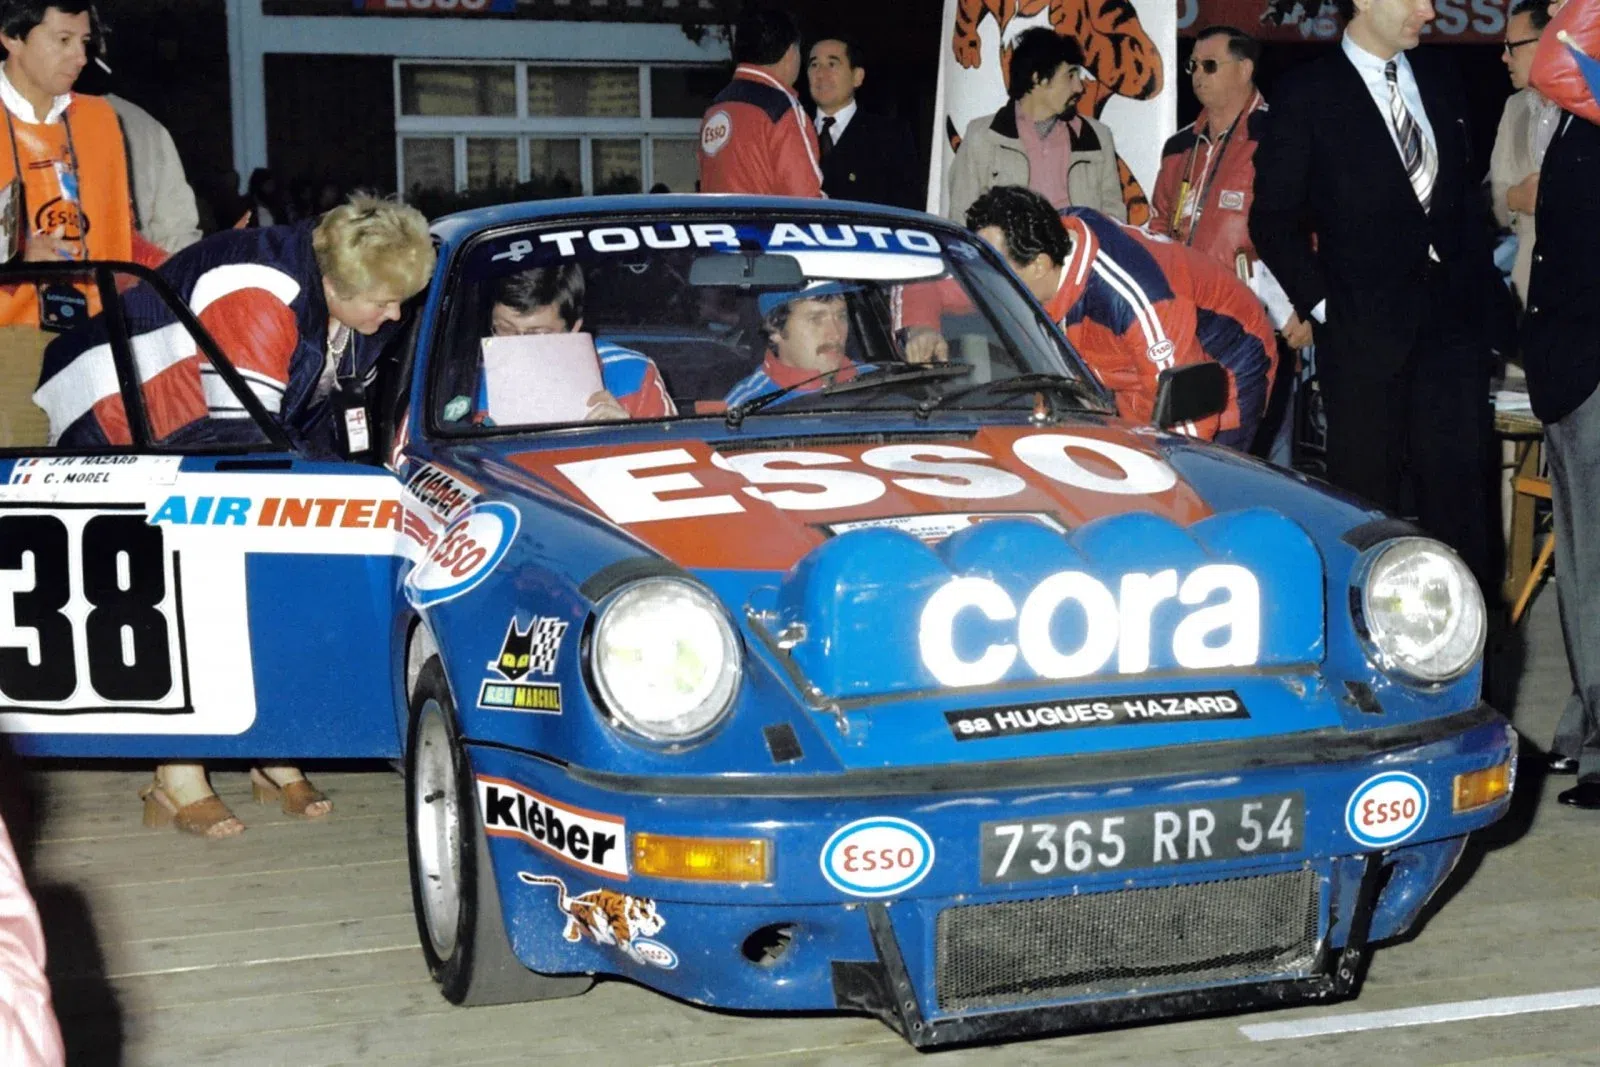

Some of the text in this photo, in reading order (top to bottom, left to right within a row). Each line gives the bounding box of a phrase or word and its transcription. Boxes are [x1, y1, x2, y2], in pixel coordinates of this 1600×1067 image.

[539, 222, 943, 257] TOUR AUTO
[63, 471, 111, 484] MOREL
[80, 455, 139, 466] HAZARD
[553, 434, 1178, 524] ESSO
[149, 495, 253, 526] AIR
[0, 514, 174, 701] 38
[918, 563, 1261, 688] cora
[957, 694, 1239, 735] sa HUGUES HAZARD
[485, 785, 617, 866] kléber
[1361, 798, 1416, 827] Esso
[994, 798, 1294, 878] 7365 RR 54
[843, 844, 916, 873] Esso
